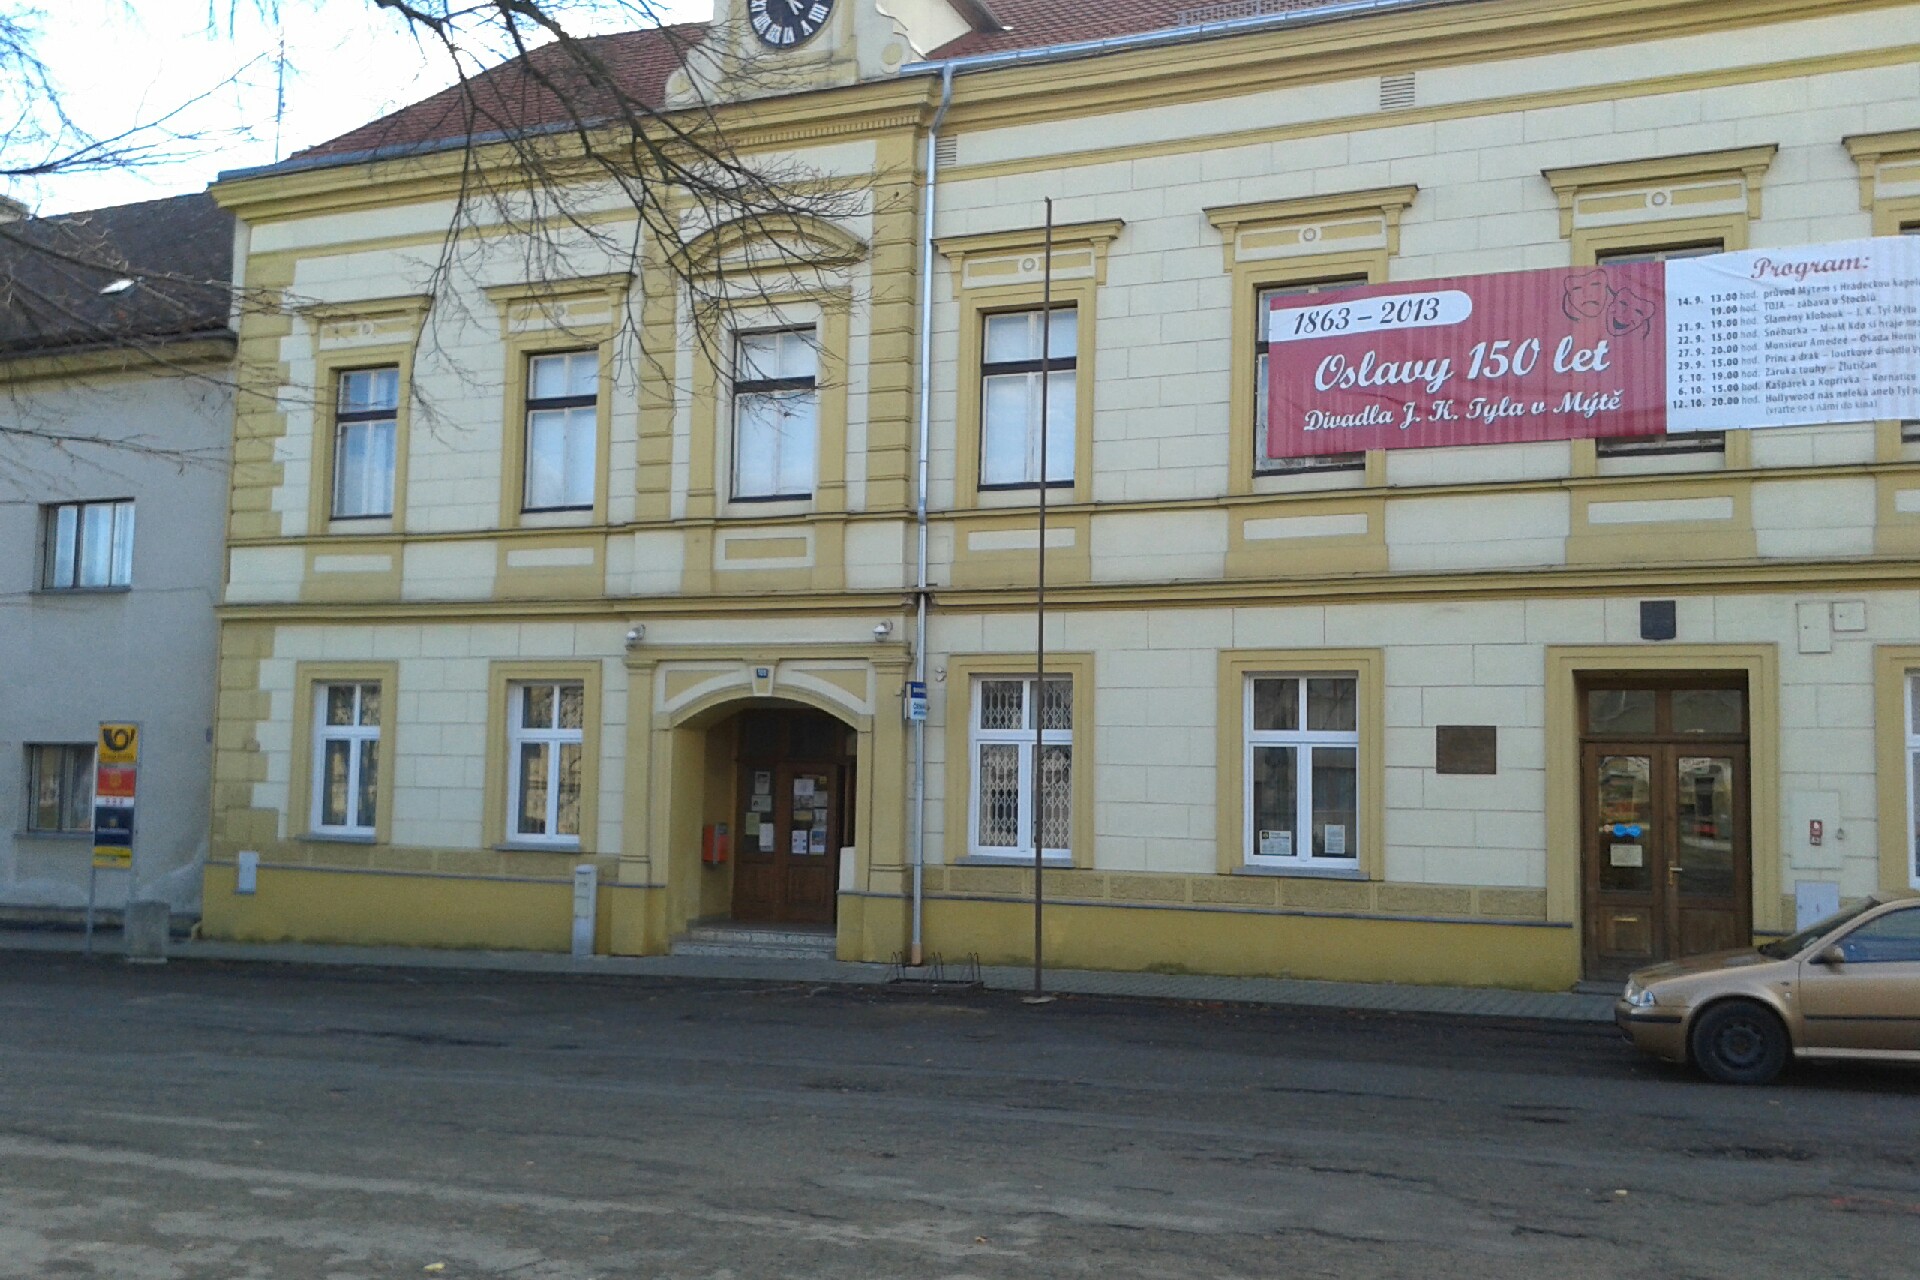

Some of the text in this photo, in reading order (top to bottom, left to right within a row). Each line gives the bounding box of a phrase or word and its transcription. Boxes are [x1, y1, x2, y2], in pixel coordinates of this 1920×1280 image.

[1751, 257, 1870, 281] Program:
[1294, 308, 1350, 335] 1863
[1380, 298, 1440, 324] 2013
[1315, 335, 1611, 394] Oslavy 150 let
[1303, 389, 1624, 431] Divadla J. K. Tyla v Mýtě
